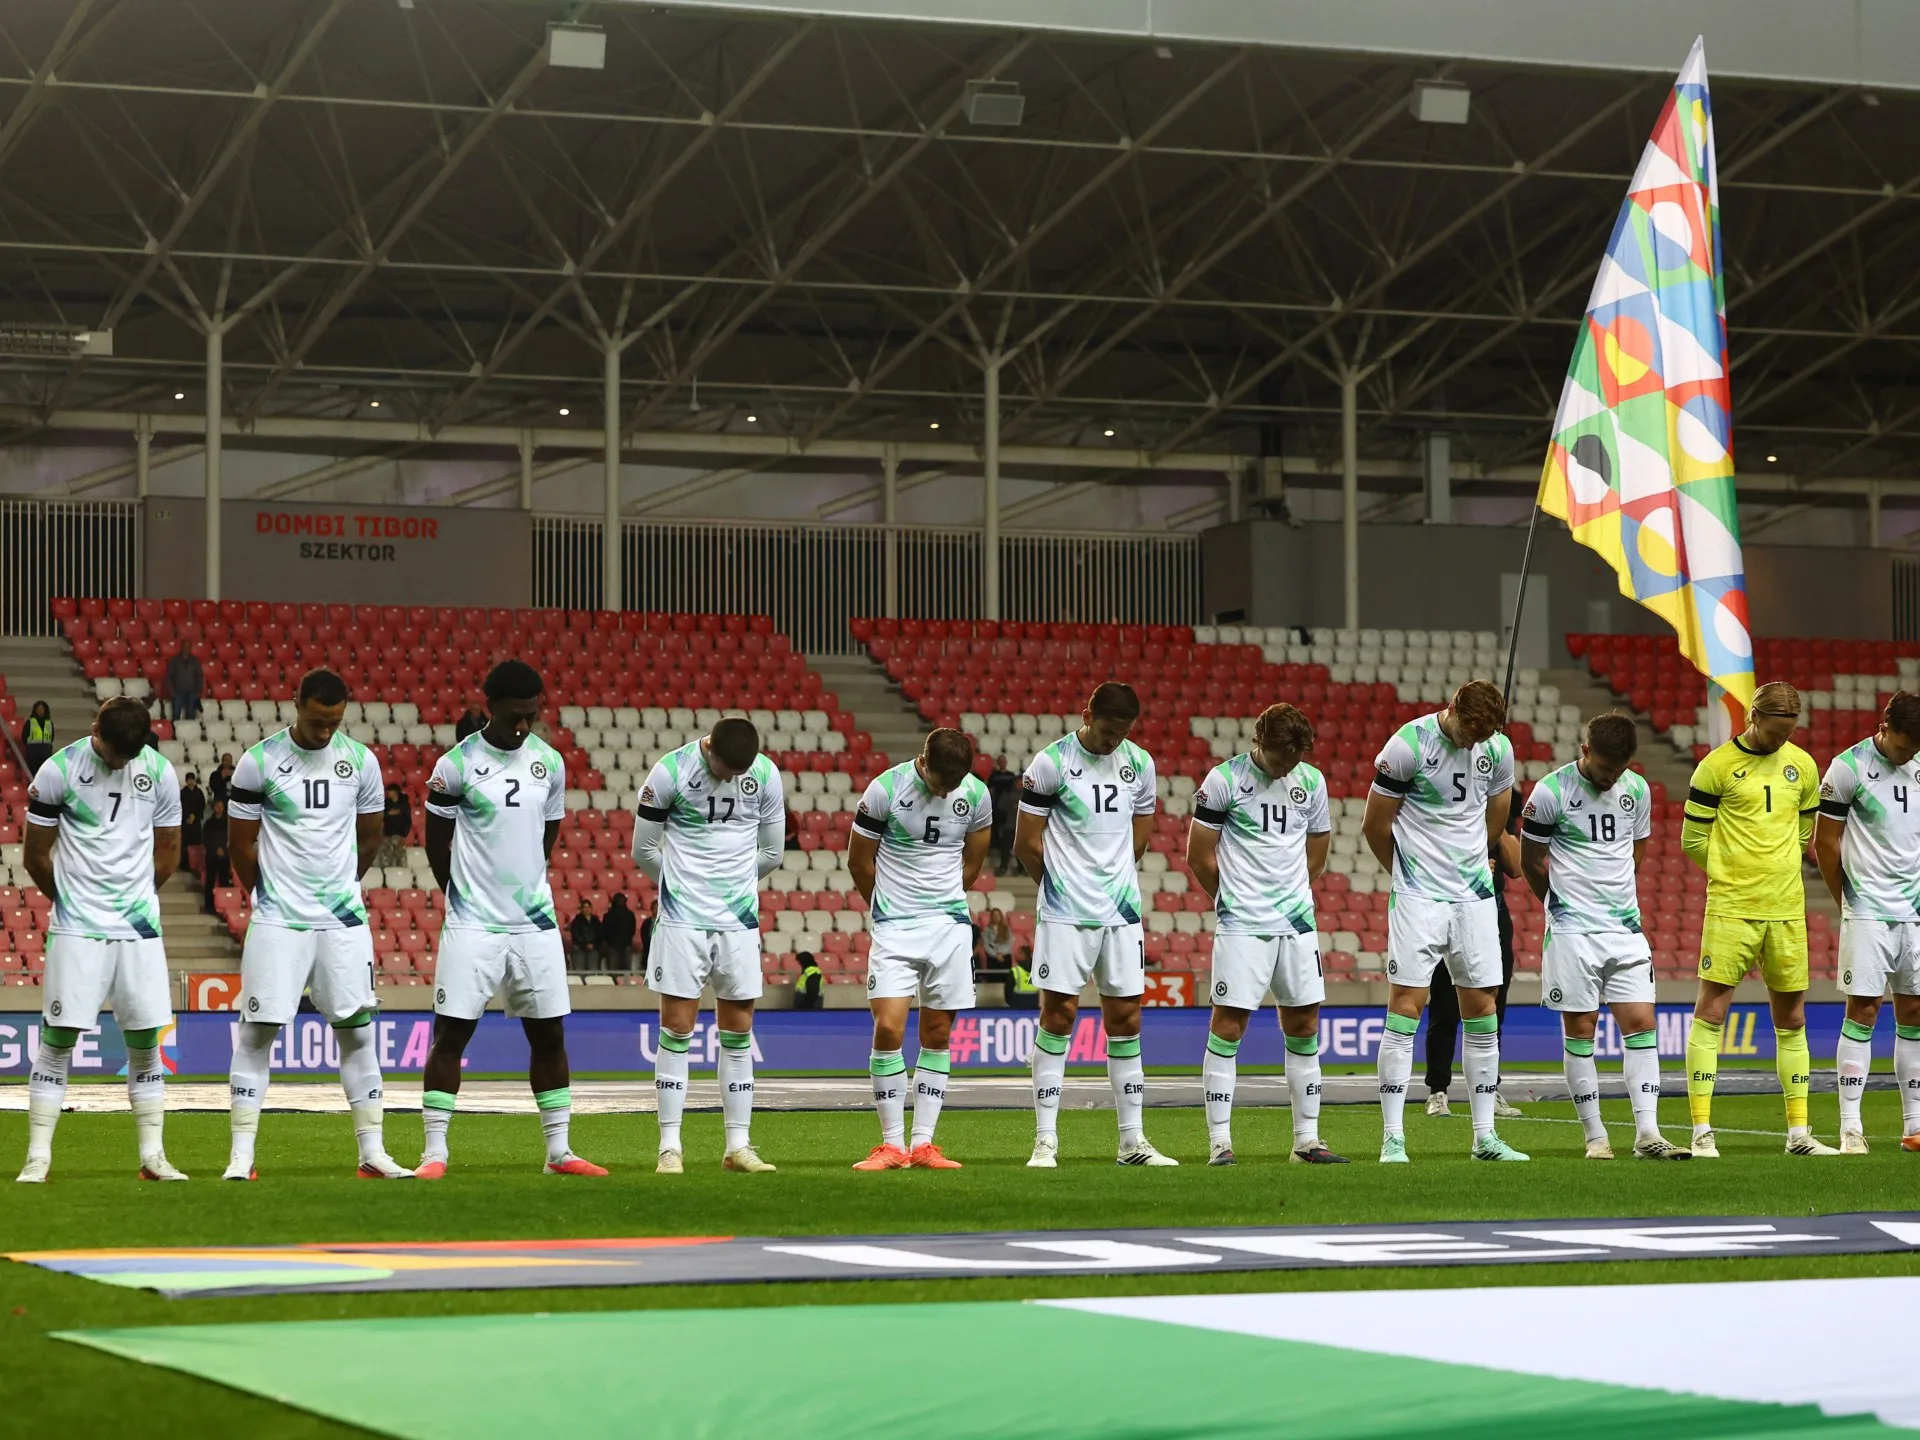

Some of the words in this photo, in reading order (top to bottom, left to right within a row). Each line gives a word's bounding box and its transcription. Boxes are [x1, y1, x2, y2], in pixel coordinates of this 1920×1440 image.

[257, 511, 345, 537] DOMBI
[354, 515, 439, 539] TIBOR
[300, 542, 396, 562] SZEKTOR
[303, 780, 330, 809] 10
[505, 779, 520, 807] 2
[1092, 784, 1118, 813] 12
[1452, 773, 1466, 802] 5
[1763, 785, 1772, 813] 1
[1894, 786, 1908, 813] 4
[108, 793, 121, 822] 7
[707, 796, 735, 824] 17
[1260, 803, 1287, 834] 14
[924, 816, 940, 844] 6
[1588, 814, 1615, 842] 18
[198, 978, 243, 1011] C
[32, 1072, 63, 1086] ÉIRE
[1380, 1084, 1405, 1094] ÉIRE
[1840, 1076, 1864, 1086] ÉIRE
[1206, 1091, 1231, 1102] ÉIRE
[1574, 1091, 1598, 1104] ÉIRE
